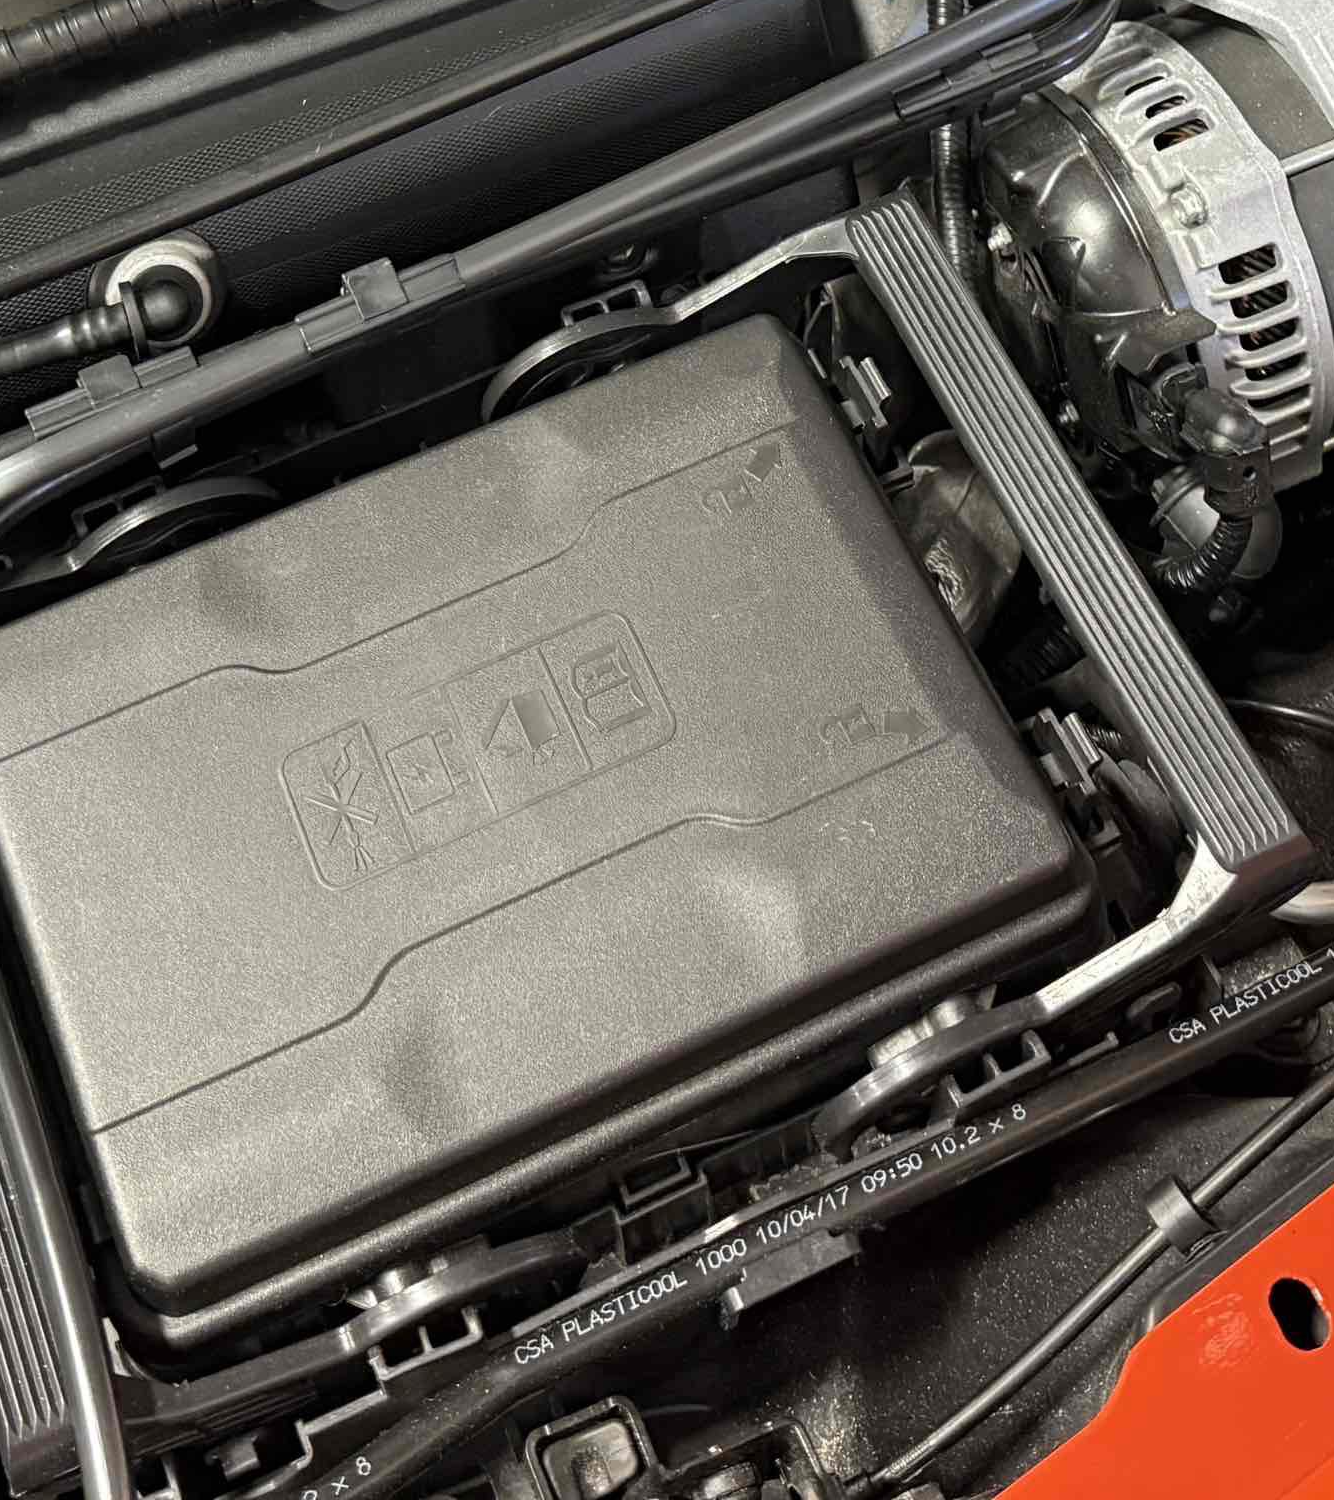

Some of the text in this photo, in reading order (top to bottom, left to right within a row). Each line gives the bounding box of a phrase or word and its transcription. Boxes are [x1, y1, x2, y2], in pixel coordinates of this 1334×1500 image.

[1169, 1018, 1207, 1044] CSA
[1209, 960, 1323, 1025] PLASTICOOL
[515, 1334, 555, 1364] CSA
[561, 1270, 688, 1342] PLASTICOOL
[695, 1237, 747, 1276] 1000
[756, 1185, 849, 1244] 10/04/17
[860, 1152, 923, 1193] 09:50
[930, 1126, 981, 1159] 10.2
[1011, 1103, 1026, 1120] 8
[355, 1456, 371, 1476] 8
